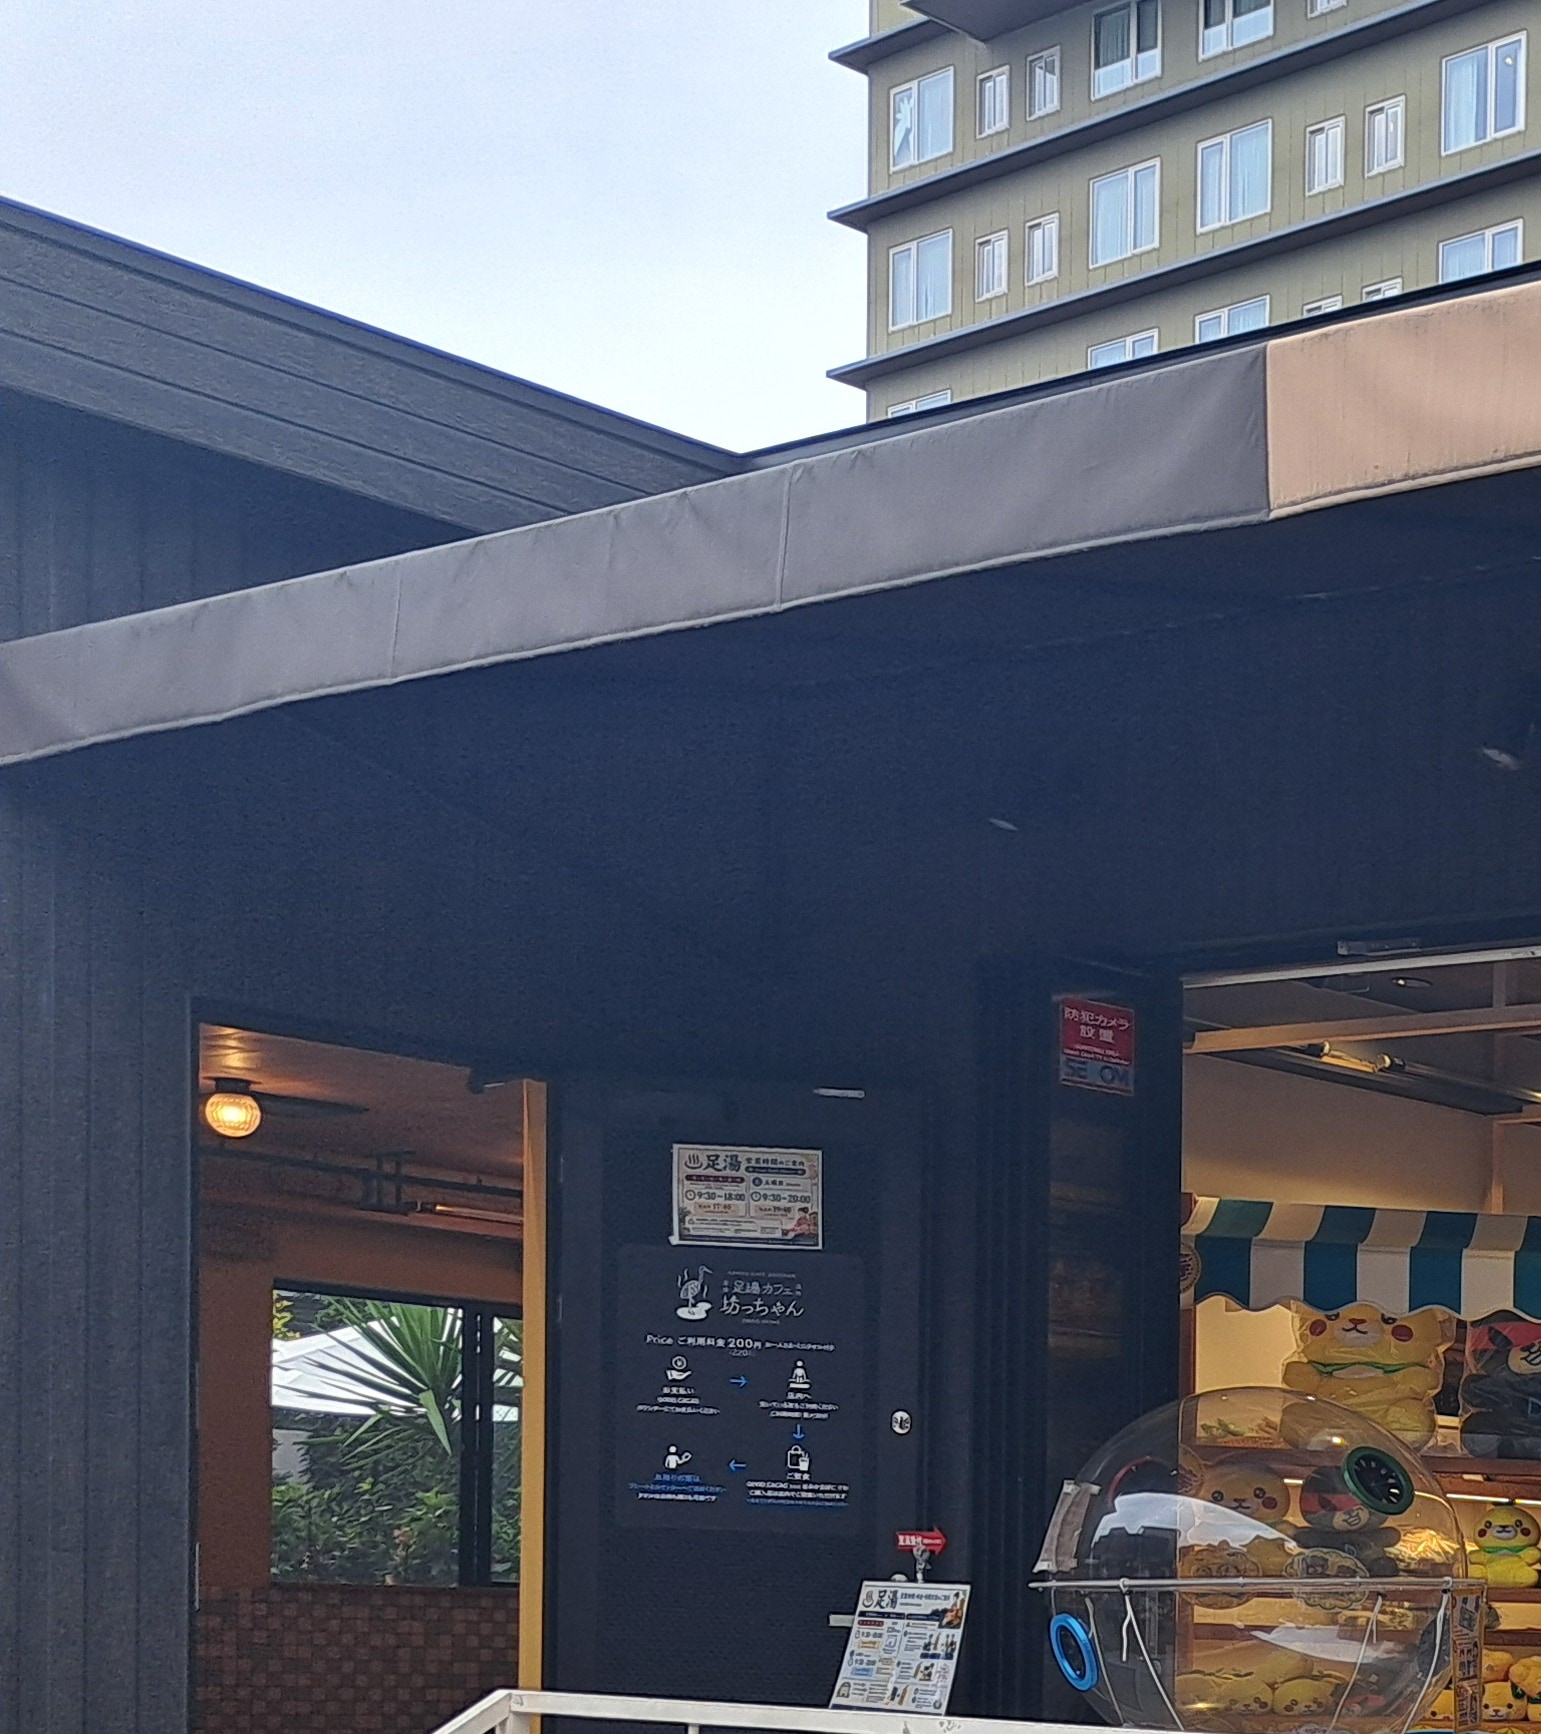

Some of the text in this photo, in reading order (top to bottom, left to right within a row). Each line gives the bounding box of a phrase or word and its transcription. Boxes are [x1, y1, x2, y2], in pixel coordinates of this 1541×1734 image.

[1064, 1006, 1130, 1031] 防犯カメラ
[1079, 1025, 1115, 1044] 設置
[703, 1153, 742, 1173] 足湯
[720, 1295, 804, 1317] 坊っちゃん
[645, 1334, 674, 1345] Price
[873, 1589, 899, 1610] 足湯
